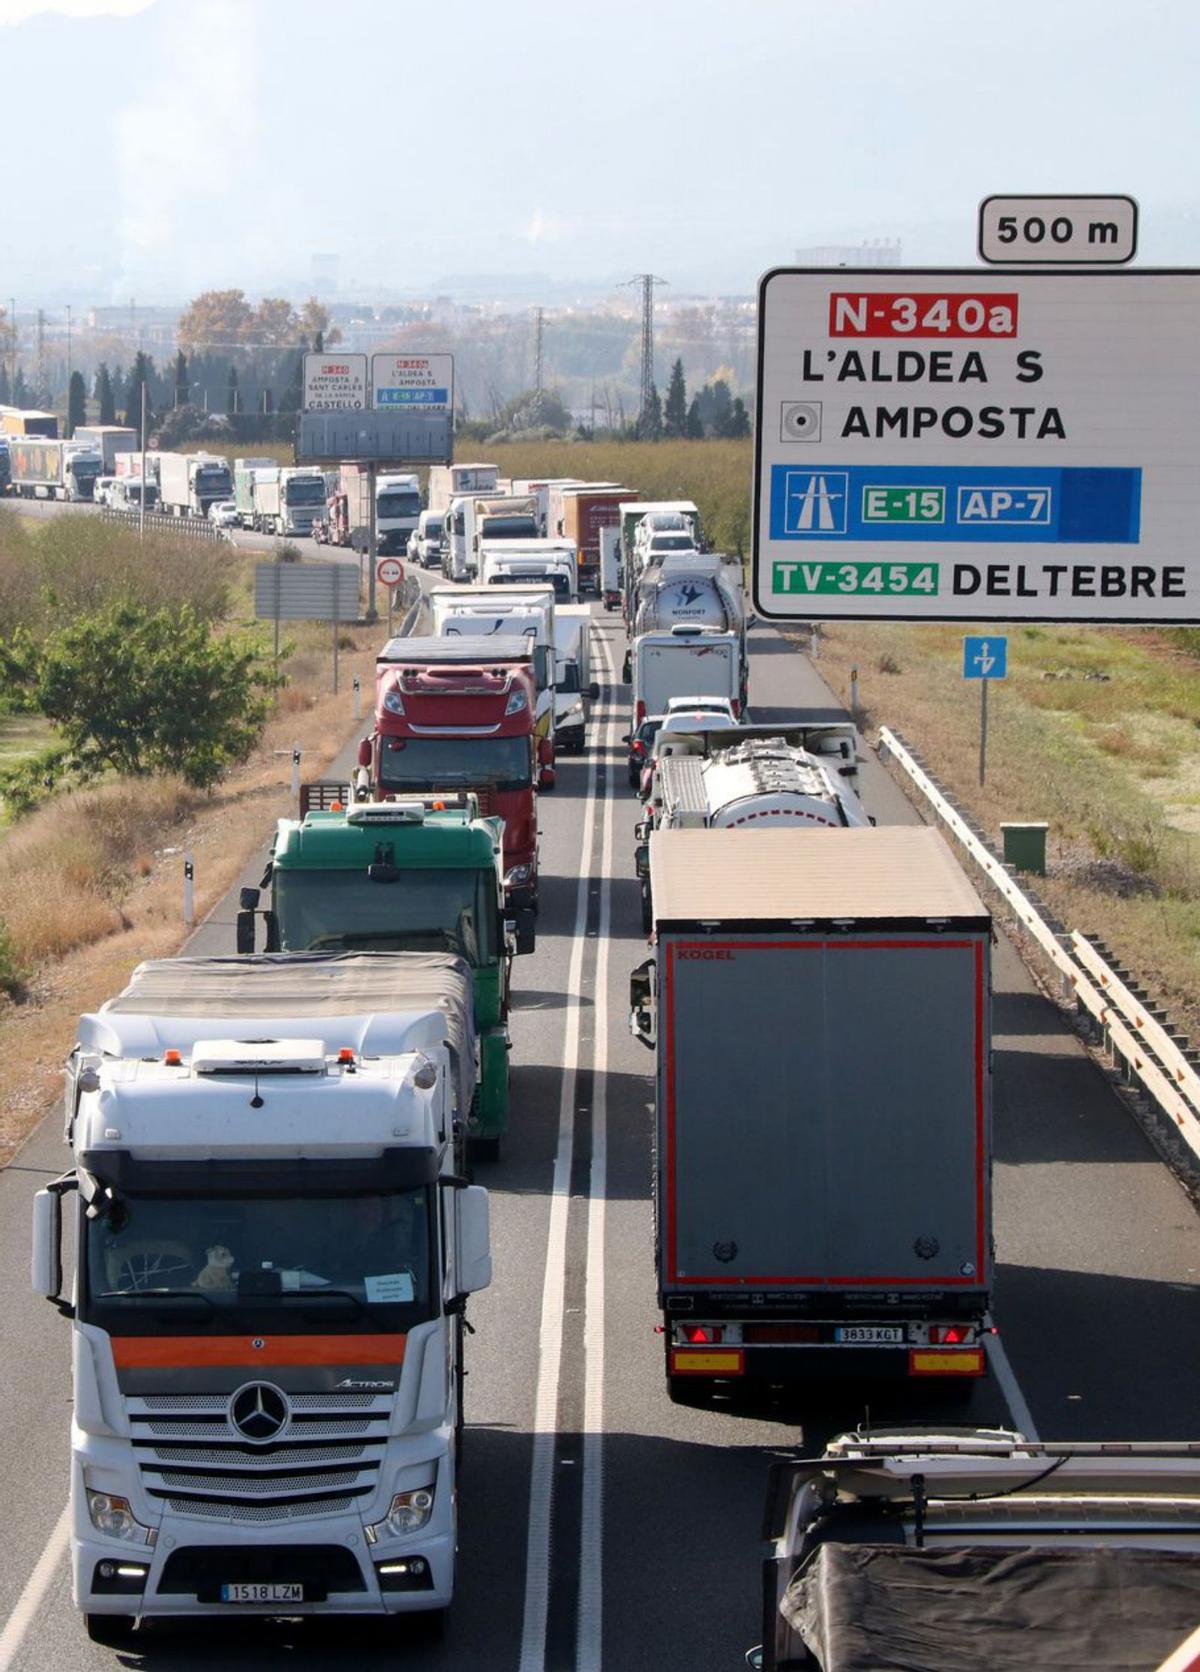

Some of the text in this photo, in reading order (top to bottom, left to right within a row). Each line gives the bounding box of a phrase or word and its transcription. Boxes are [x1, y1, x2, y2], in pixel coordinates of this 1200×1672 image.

[998, 217, 1119, 244] 500 m
[834, 297, 1015, 335] N-340a
[803, 350, 1044, 383] L'ALDEA S
[841, 406, 1066, 439] AMPOSTA
[867, 491, 1049, 519] E-15 AP-7
[777, 564, 1187, 598] TV-3454 DELTEBRE
[842, 1329, 899, 1340] 3833 KGT
[233, 1586, 300, 1599] 1518 LZM
